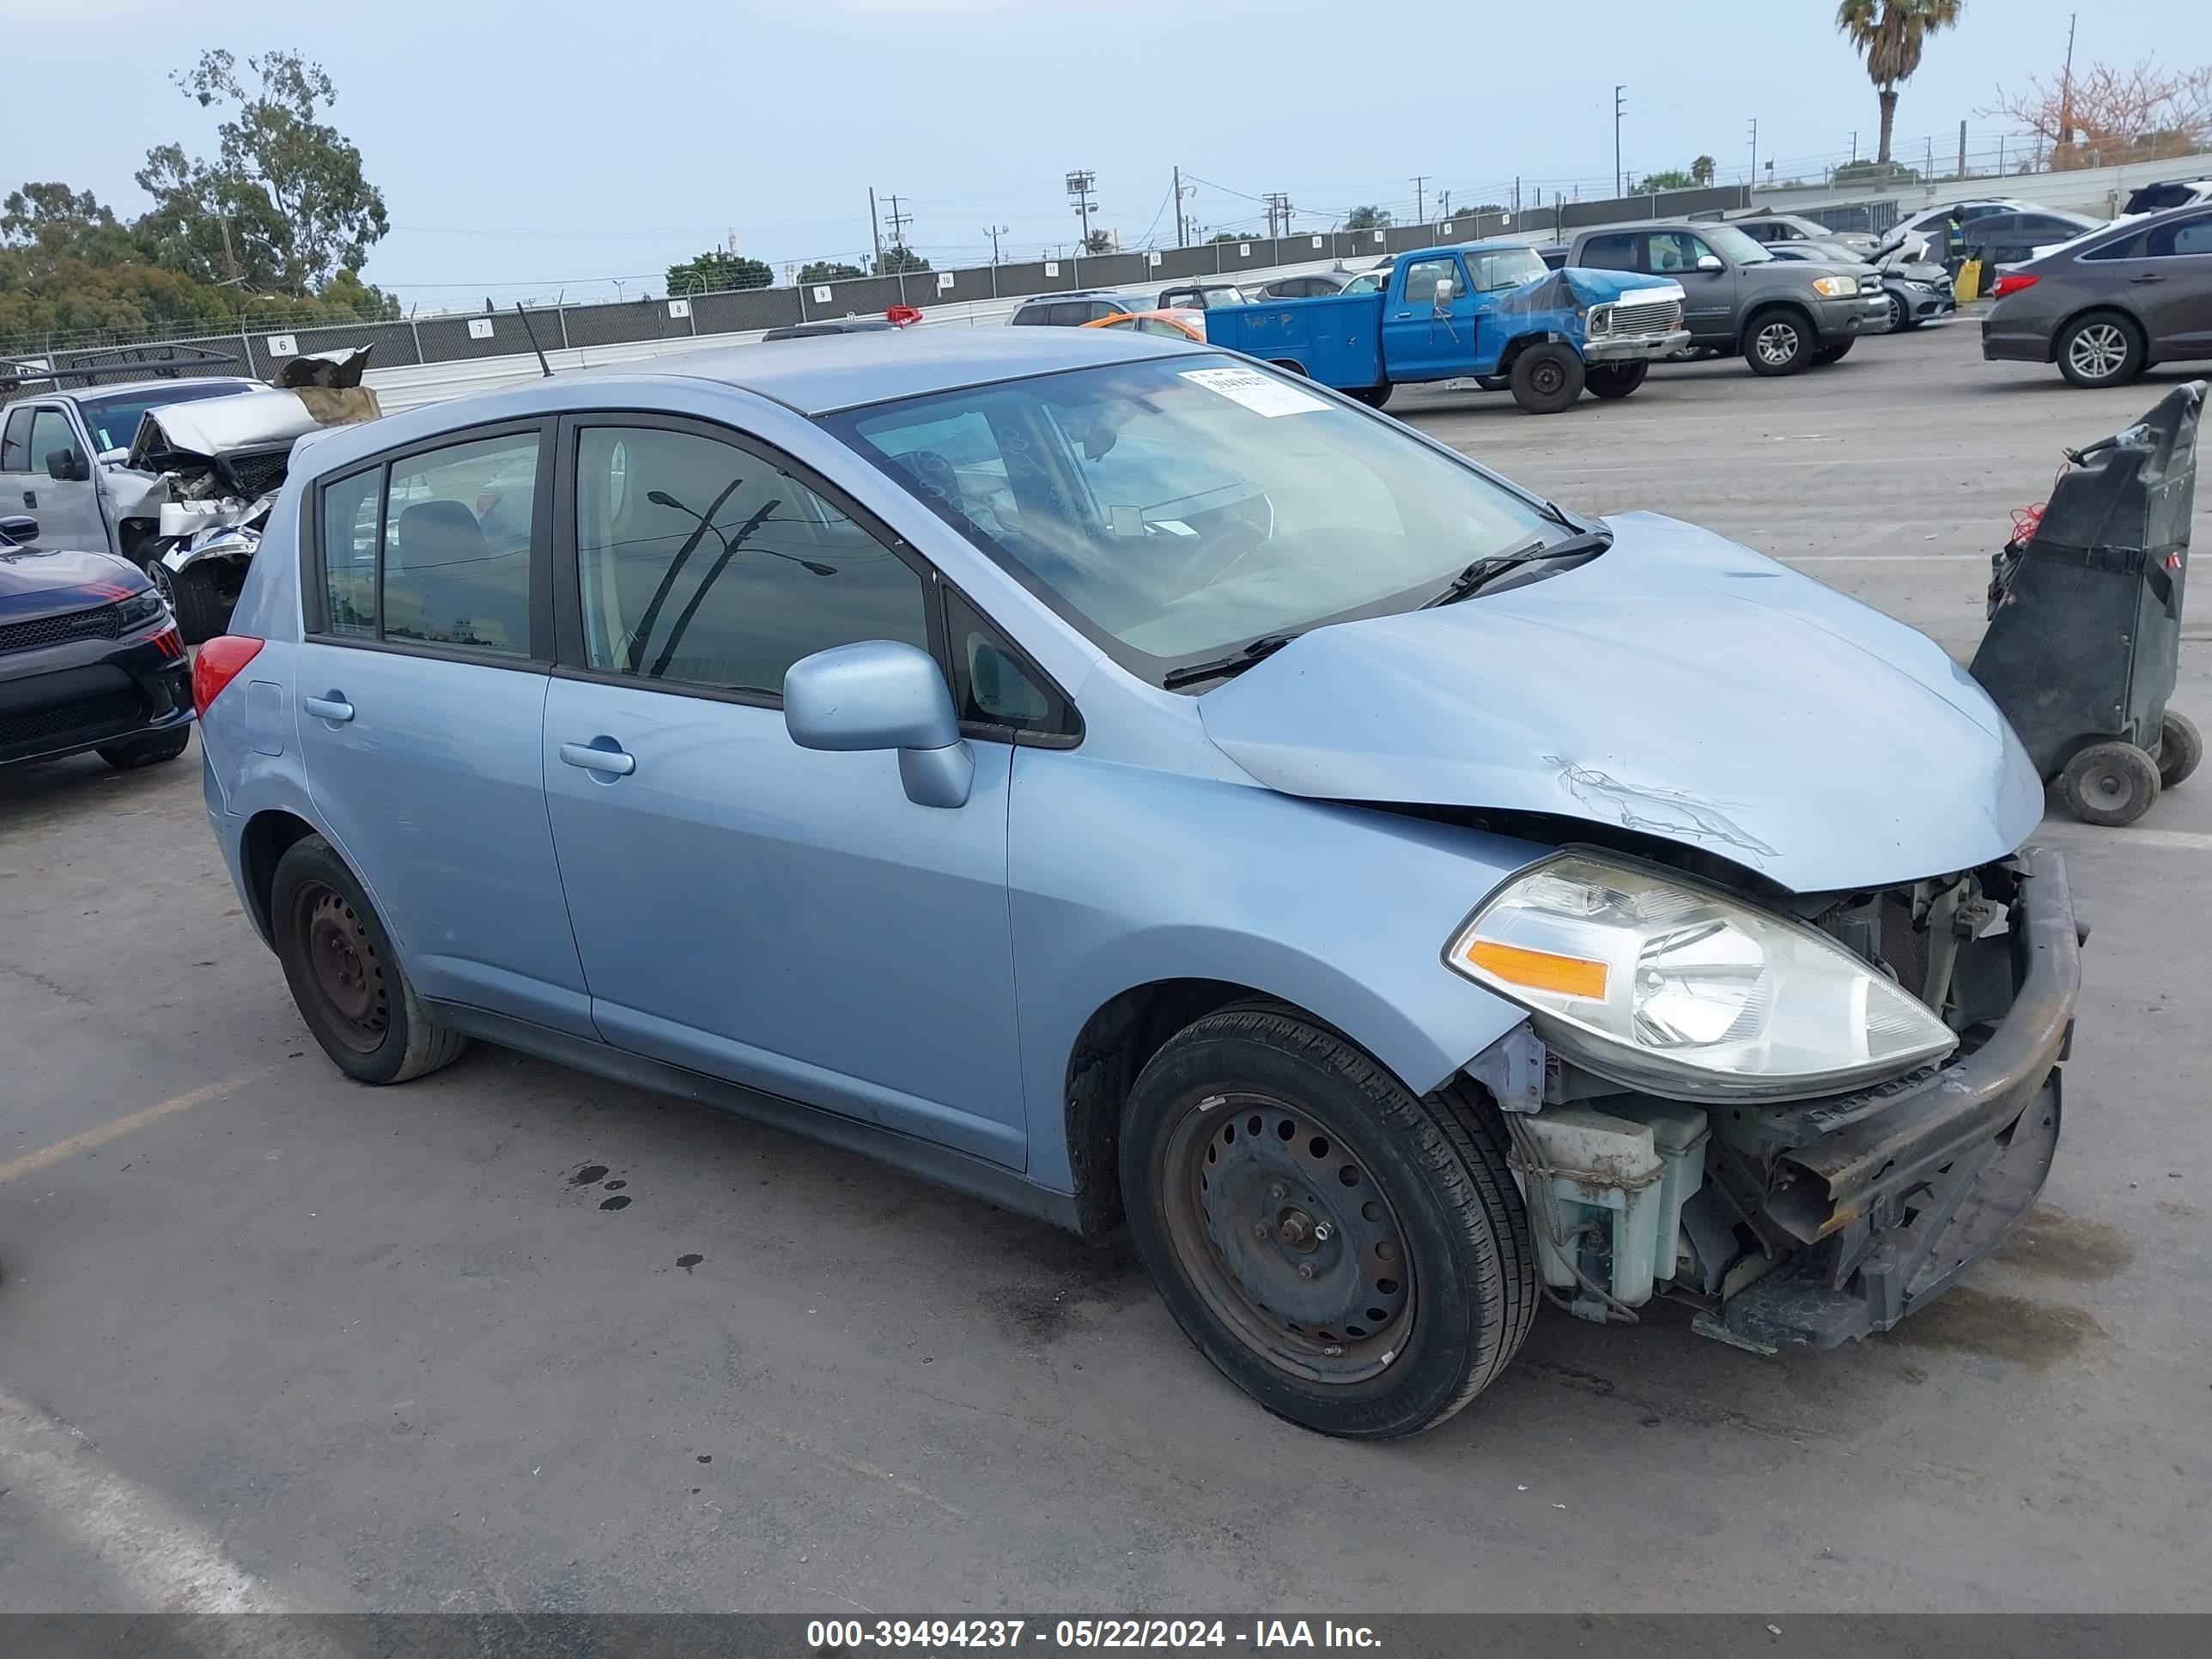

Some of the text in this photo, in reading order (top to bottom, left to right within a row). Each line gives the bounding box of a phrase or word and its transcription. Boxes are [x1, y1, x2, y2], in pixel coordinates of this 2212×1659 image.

[943, 276, 951, 284] 10
[676, 304, 682, 313] 8
[477, 324, 484, 334] 7
[279, 340, 288, 351] 6
